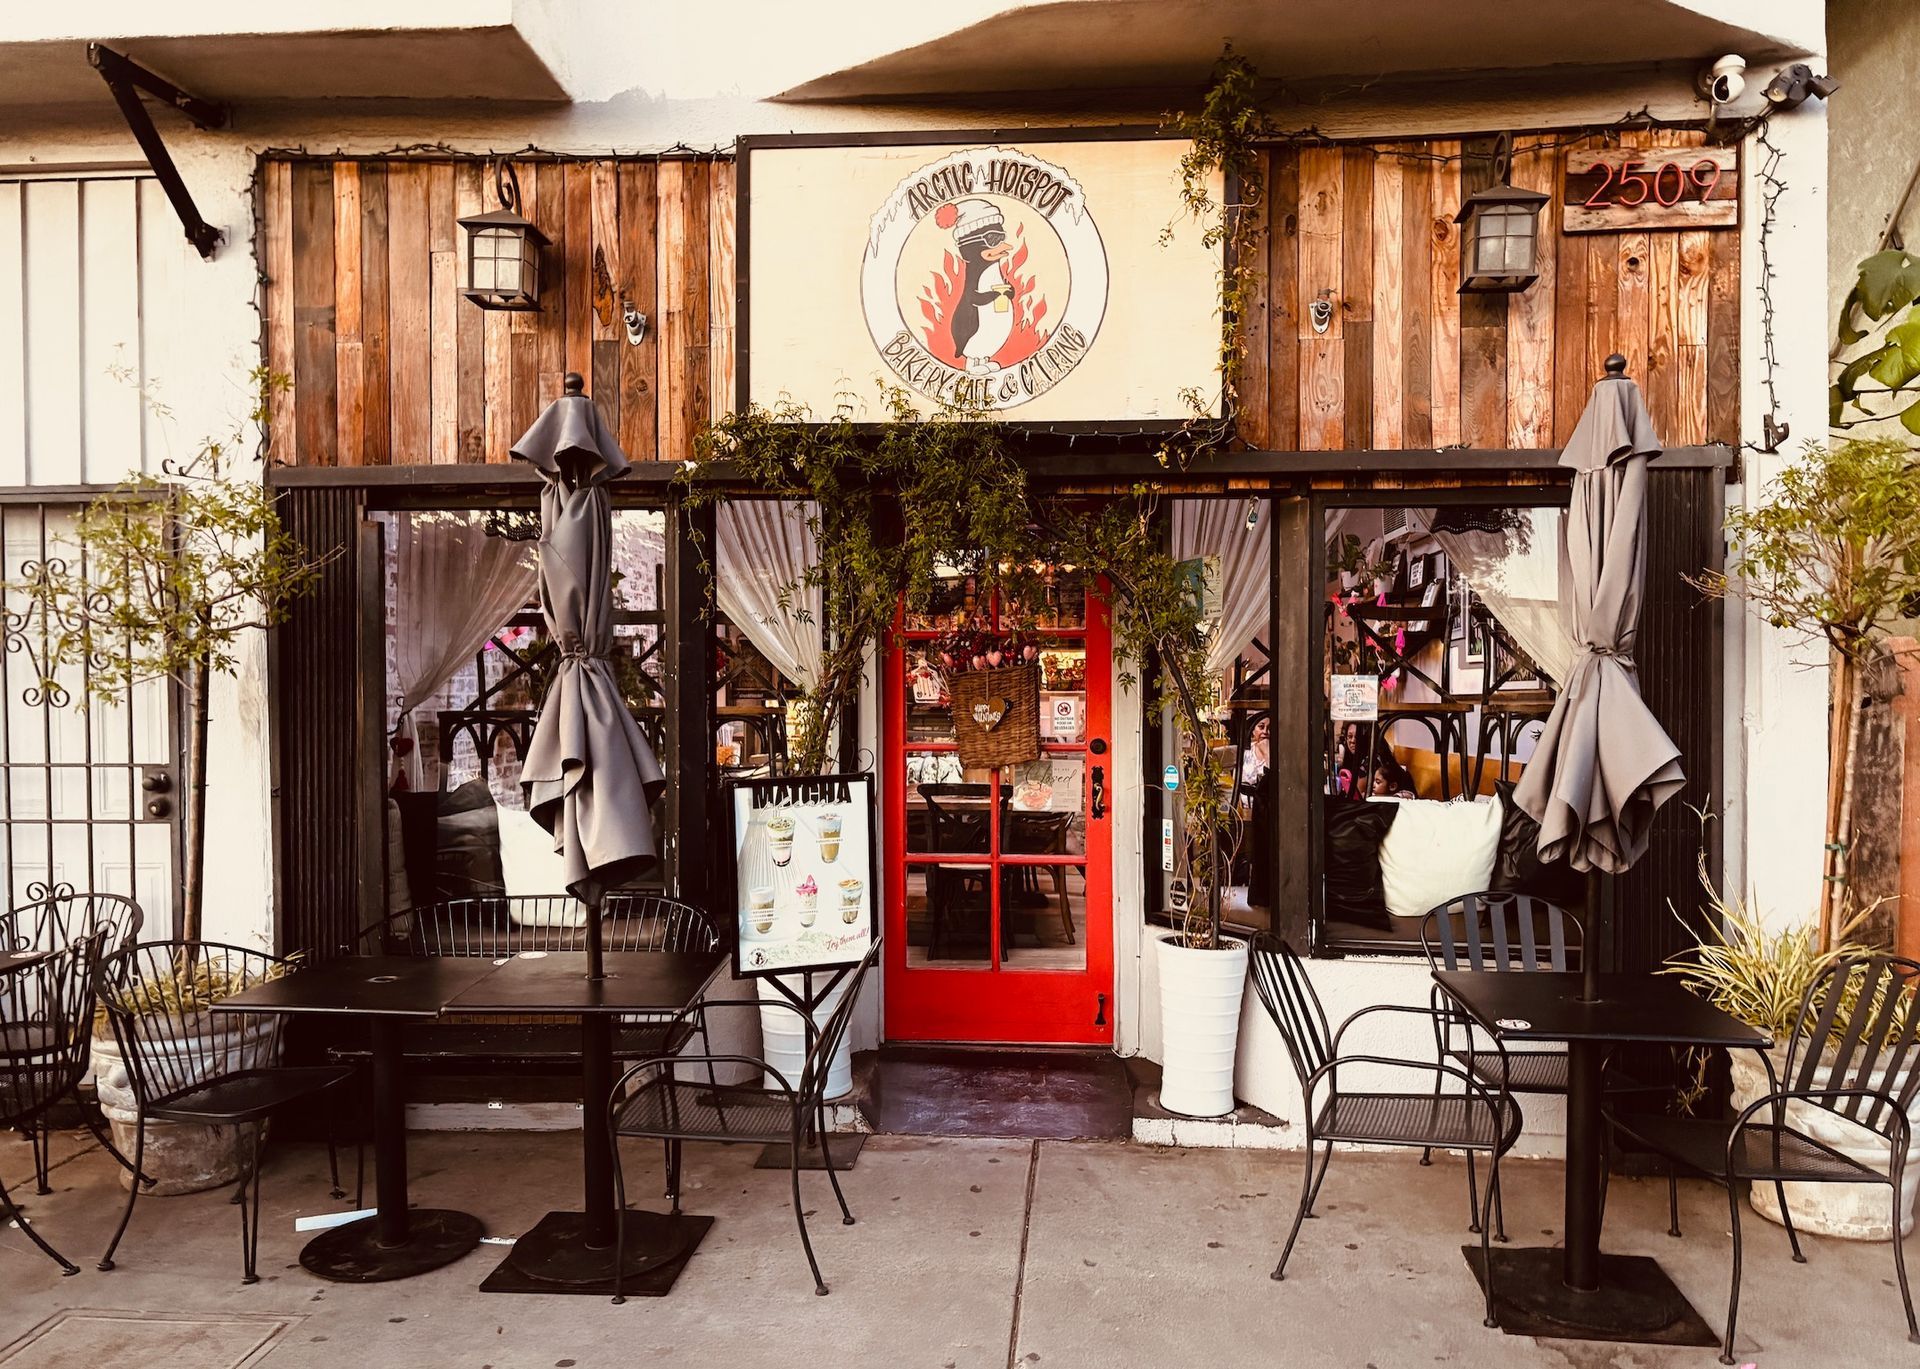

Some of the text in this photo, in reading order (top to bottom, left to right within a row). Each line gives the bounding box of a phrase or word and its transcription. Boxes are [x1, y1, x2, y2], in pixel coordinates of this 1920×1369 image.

[907, 159, 1073, 220] ARCTIC HOTSPOT
[1584, 159, 1721, 208] 2509
[884, 333, 955, 397] BAKERY
[954, 375, 997, 407] CAFE
[999, 374, 1018, 402] &
[1026, 760, 1077, 791] Closed
[752, 782, 852, 810] MATCHA
[825, 926, 870, 951] Try them all!
